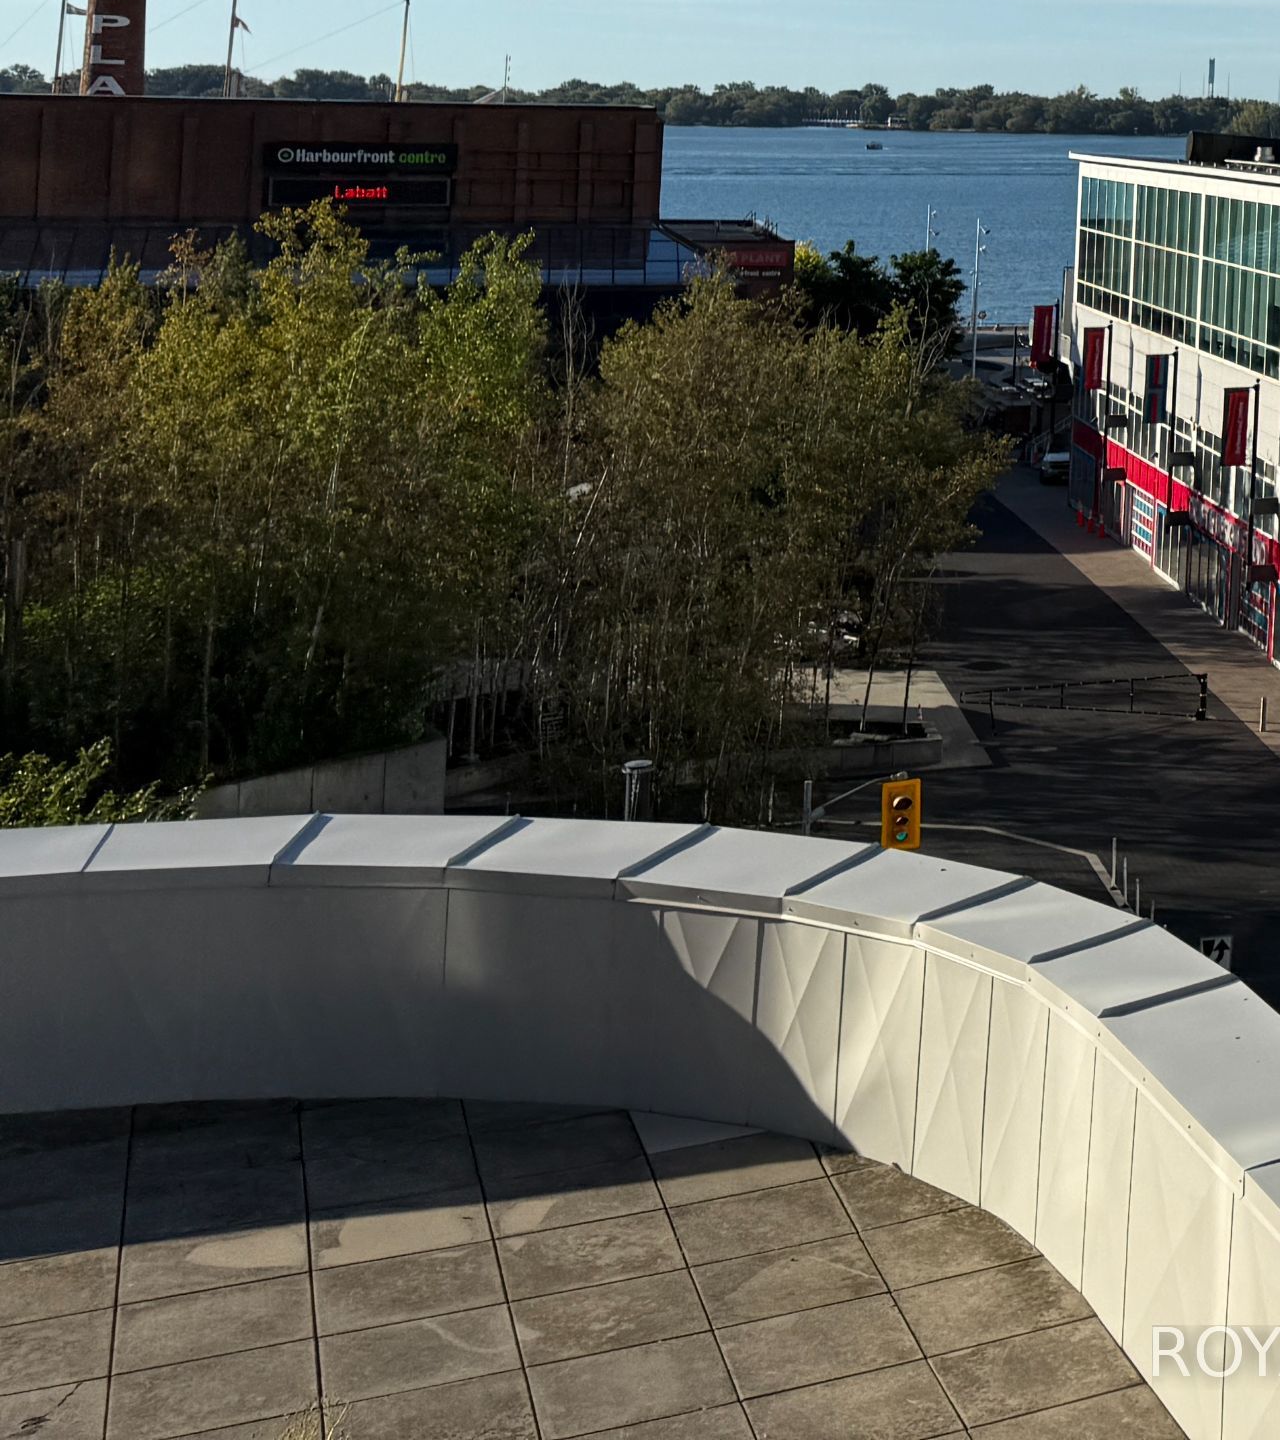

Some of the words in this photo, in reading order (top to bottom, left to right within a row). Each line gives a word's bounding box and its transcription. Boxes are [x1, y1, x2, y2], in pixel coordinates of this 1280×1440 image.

[88, 14, 130, 96] PLA
[296, 148, 395, 164] Harbourfront
[399, 150, 446, 164] centre
